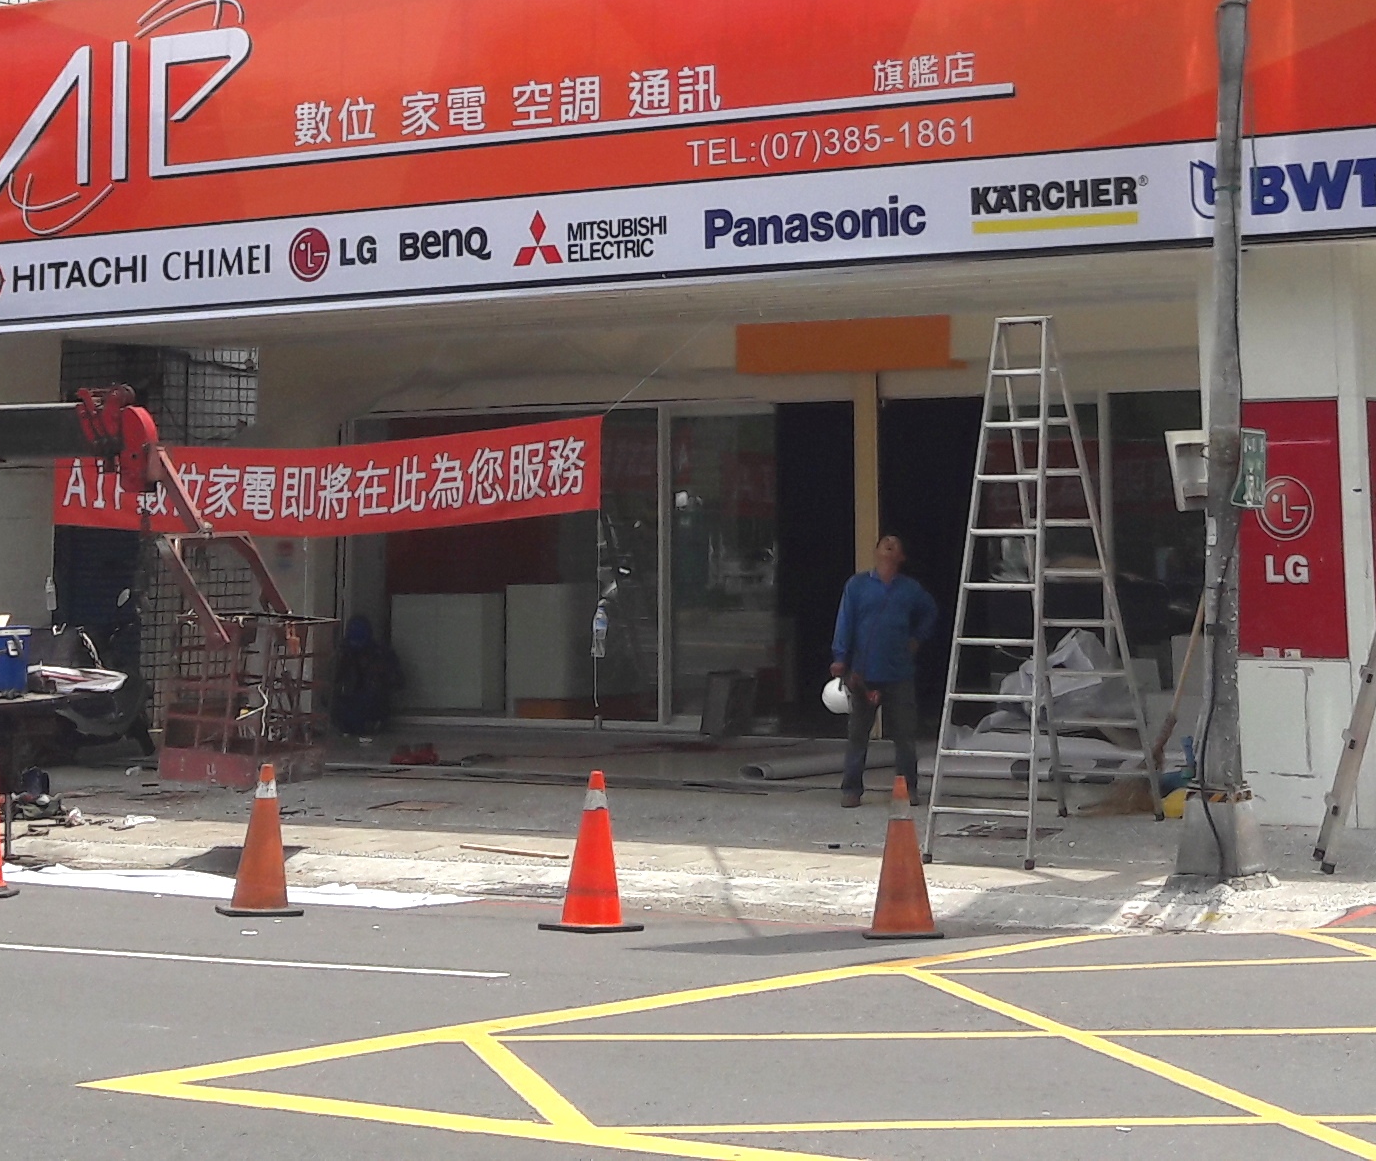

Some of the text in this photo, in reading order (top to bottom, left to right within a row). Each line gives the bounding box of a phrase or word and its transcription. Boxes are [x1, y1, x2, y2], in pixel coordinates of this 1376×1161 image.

[872, 50, 976, 93] 旗艦店
[294, 63, 723, 147] 數位 家電 空調 通訊
[566, 215, 667, 242] MITSUBISHI
[703, 194, 927, 250] Panasonic
[11, 253, 148, 294] HITACHI
[161, 242, 273, 282] CHIMEI
[339, 235, 378, 267] LG
[566, 237, 655, 264] ELECTRIC
[1264, 553, 1310, 584] LG
